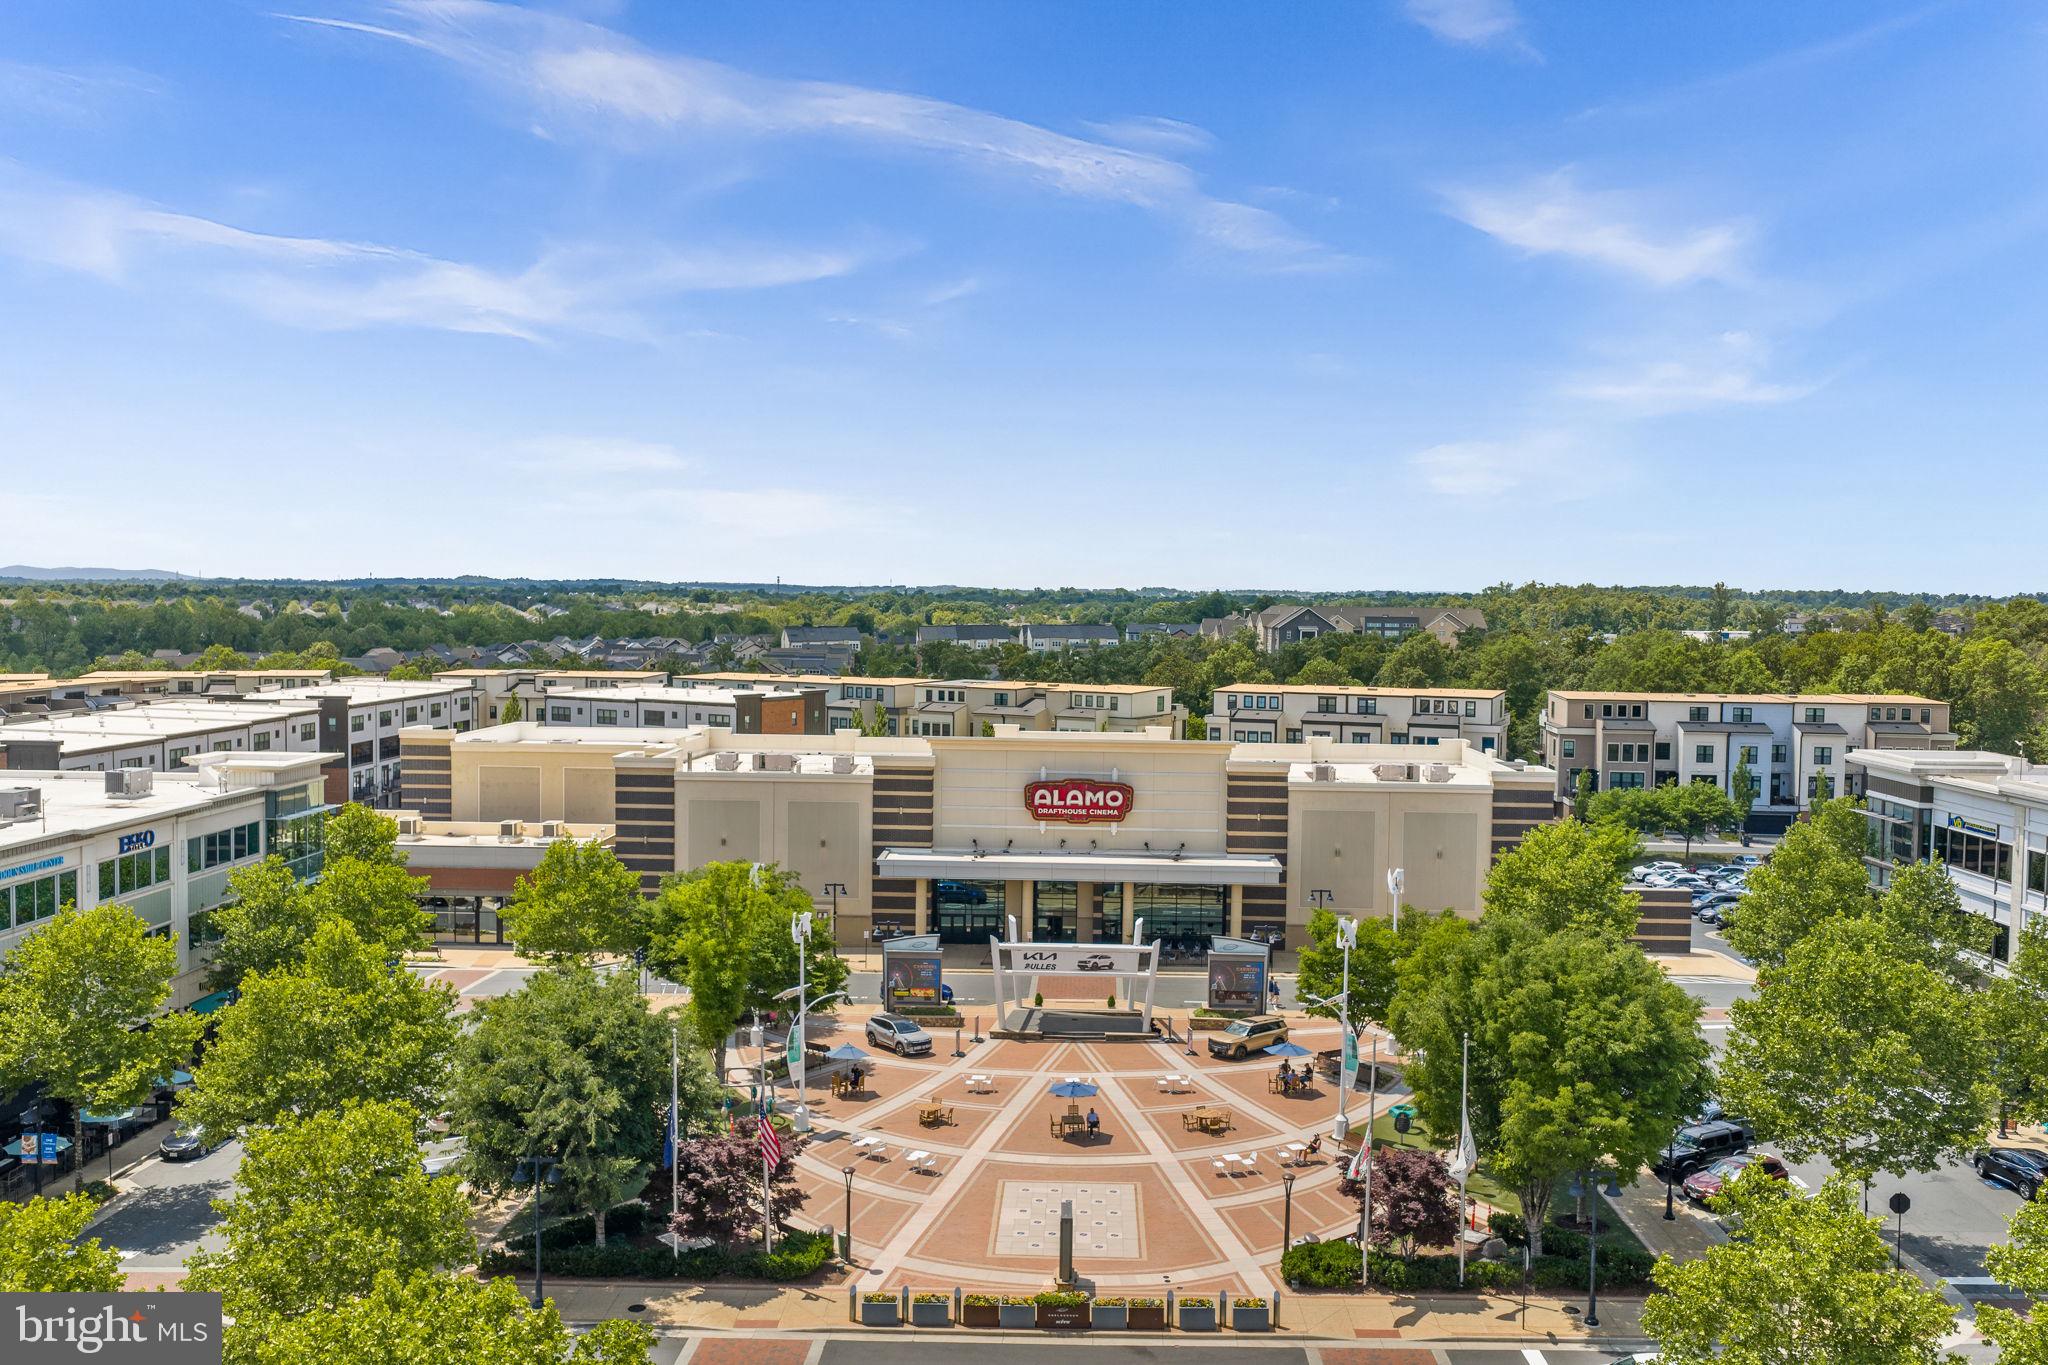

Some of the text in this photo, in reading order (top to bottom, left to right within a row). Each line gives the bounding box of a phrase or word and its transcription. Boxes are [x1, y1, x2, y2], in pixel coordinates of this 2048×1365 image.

[1034, 789, 1124, 807] ALAMO
[1038, 808, 1119, 817] DRAFTHOUSE CINEMA
[118, 830, 155, 854] EKKO
[1023, 952, 1057, 960] KIA
